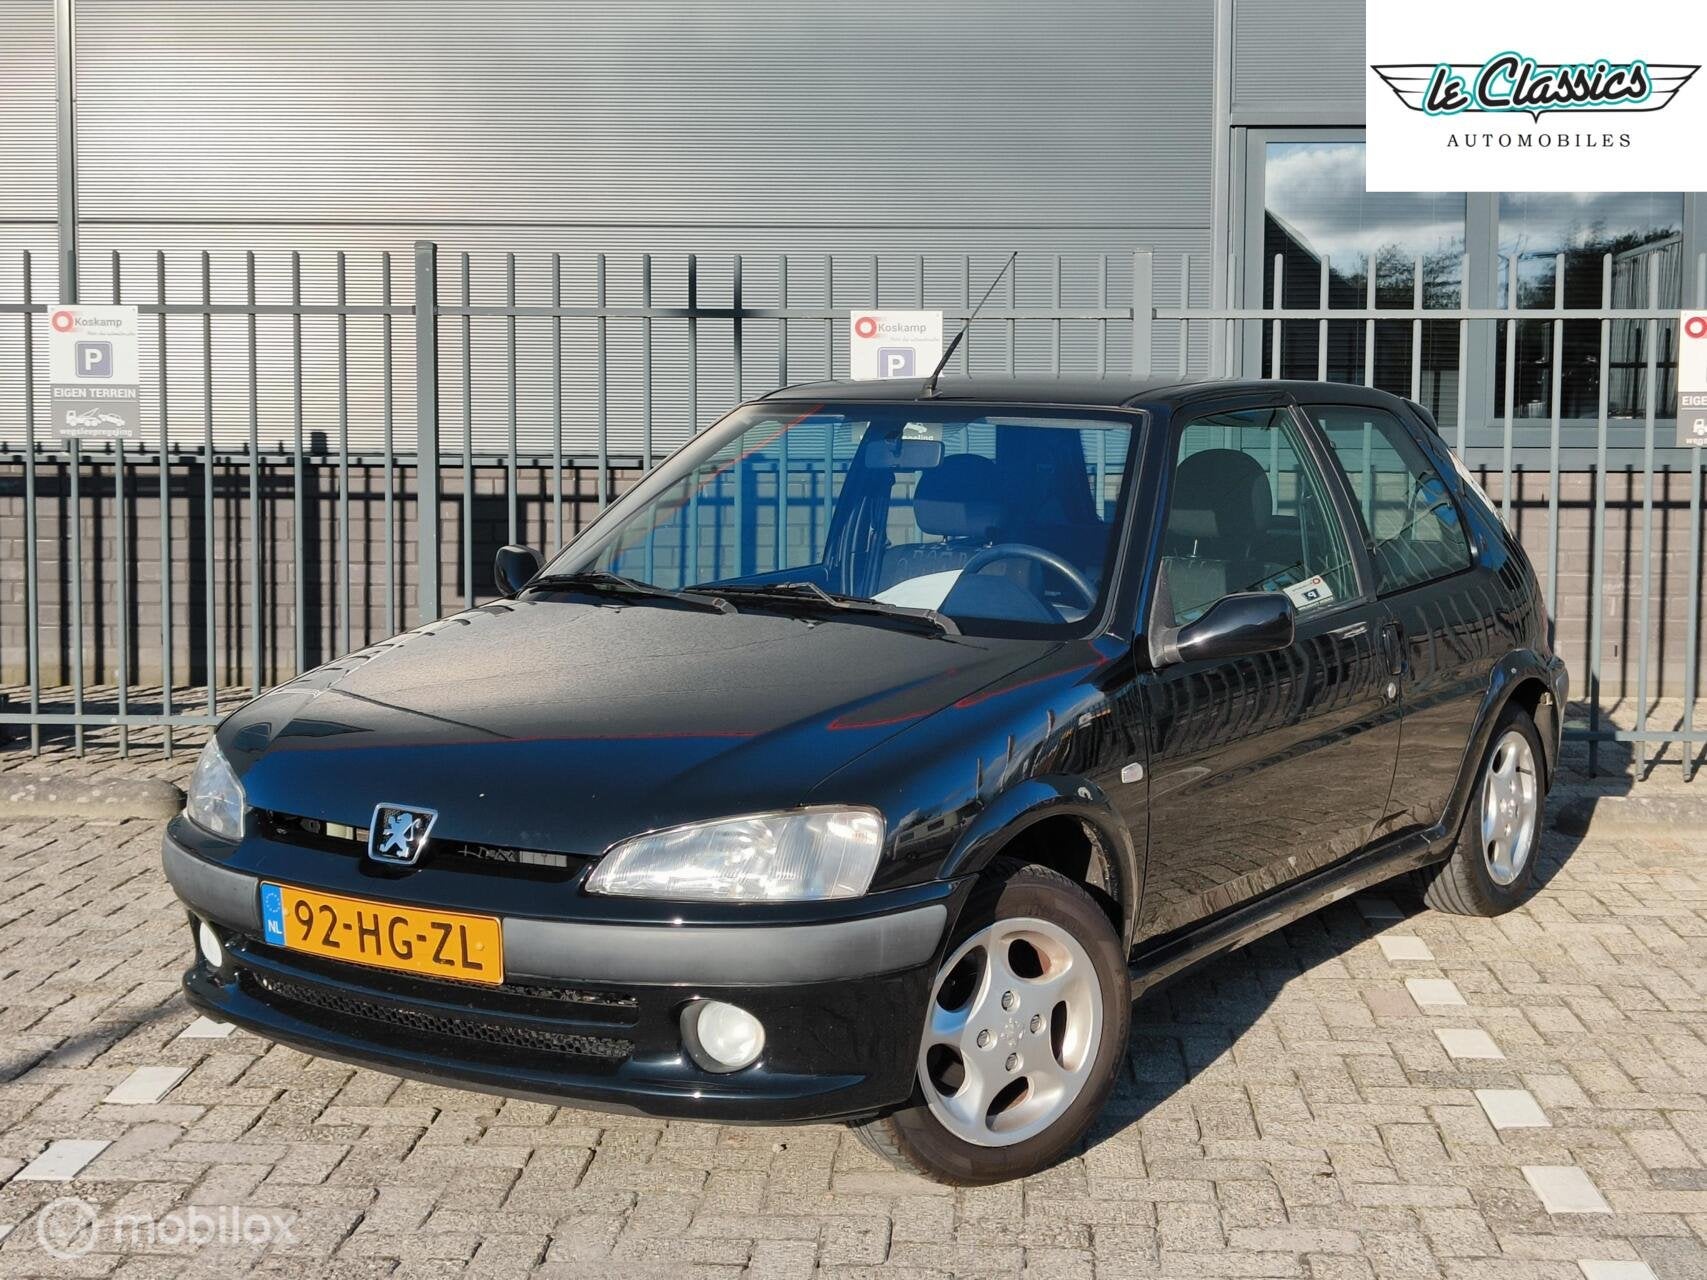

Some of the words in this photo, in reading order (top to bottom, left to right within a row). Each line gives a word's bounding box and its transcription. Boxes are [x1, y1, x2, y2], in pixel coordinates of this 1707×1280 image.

[75, 318, 122, 327] Koskamp
[878, 323, 927, 333] Koskamp
[85, 349, 102, 370] P
[888, 355, 905, 377] P
[54, 388, 87, 398] EIGEN
[90, 388, 137, 398] TERREIN
[268, 920, 283, 935] NL
[294, 900, 483, 971] 92-HG-ZL
